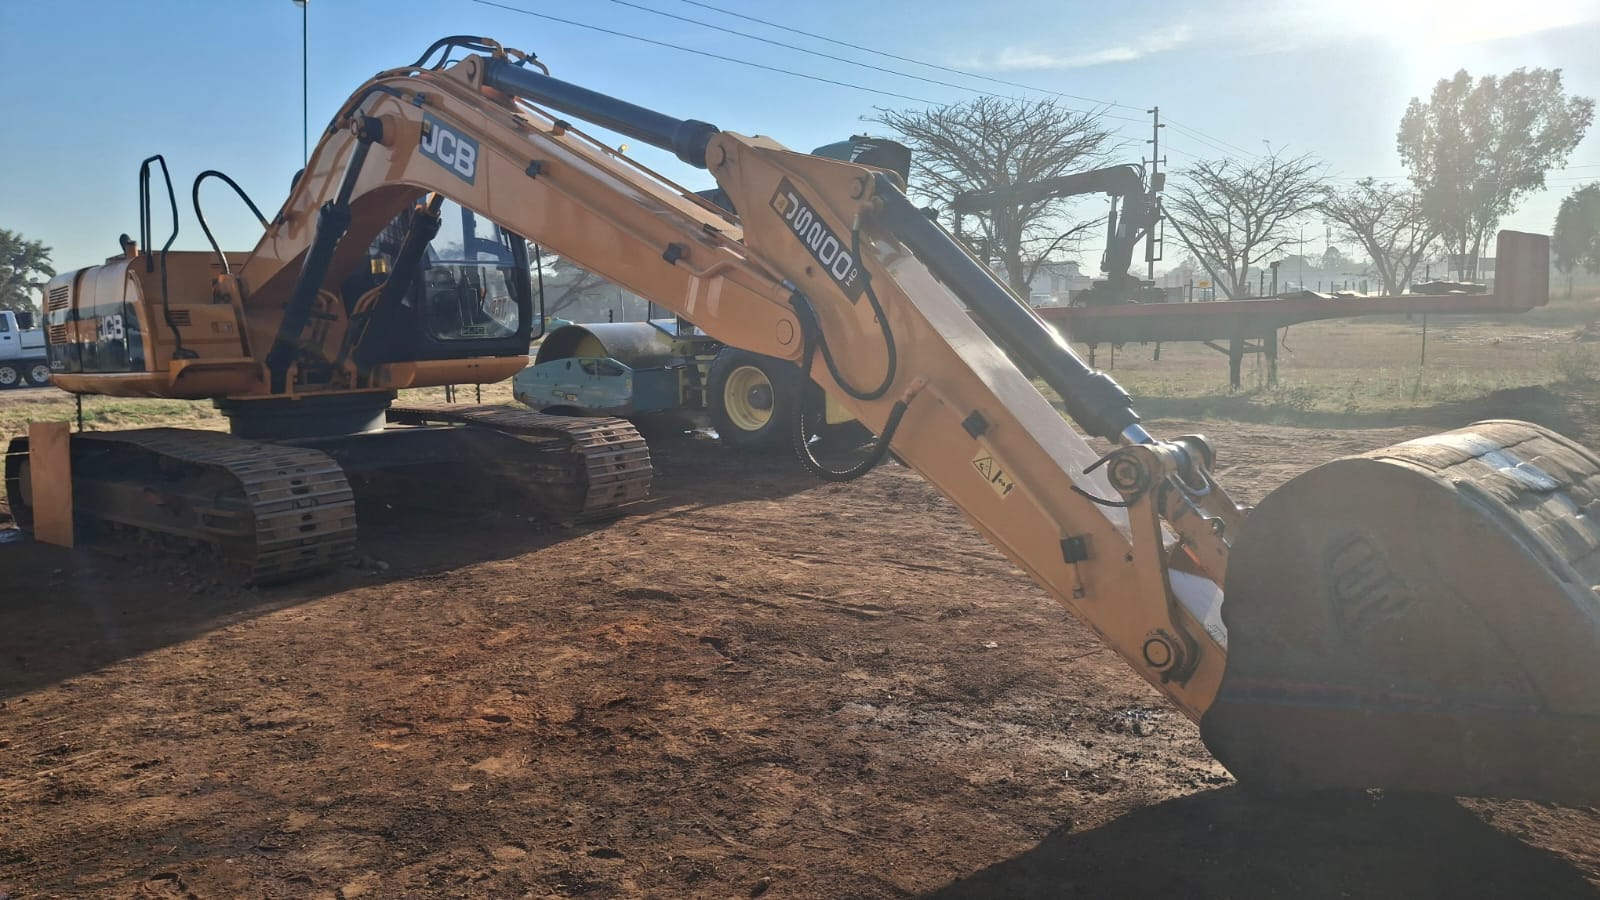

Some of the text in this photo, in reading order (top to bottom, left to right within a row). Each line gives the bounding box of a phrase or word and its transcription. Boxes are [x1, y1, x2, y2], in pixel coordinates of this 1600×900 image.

[421, 124, 476, 178] JCB
[785, 191, 853, 281] JS200
[98, 315, 124, 341] JCB
